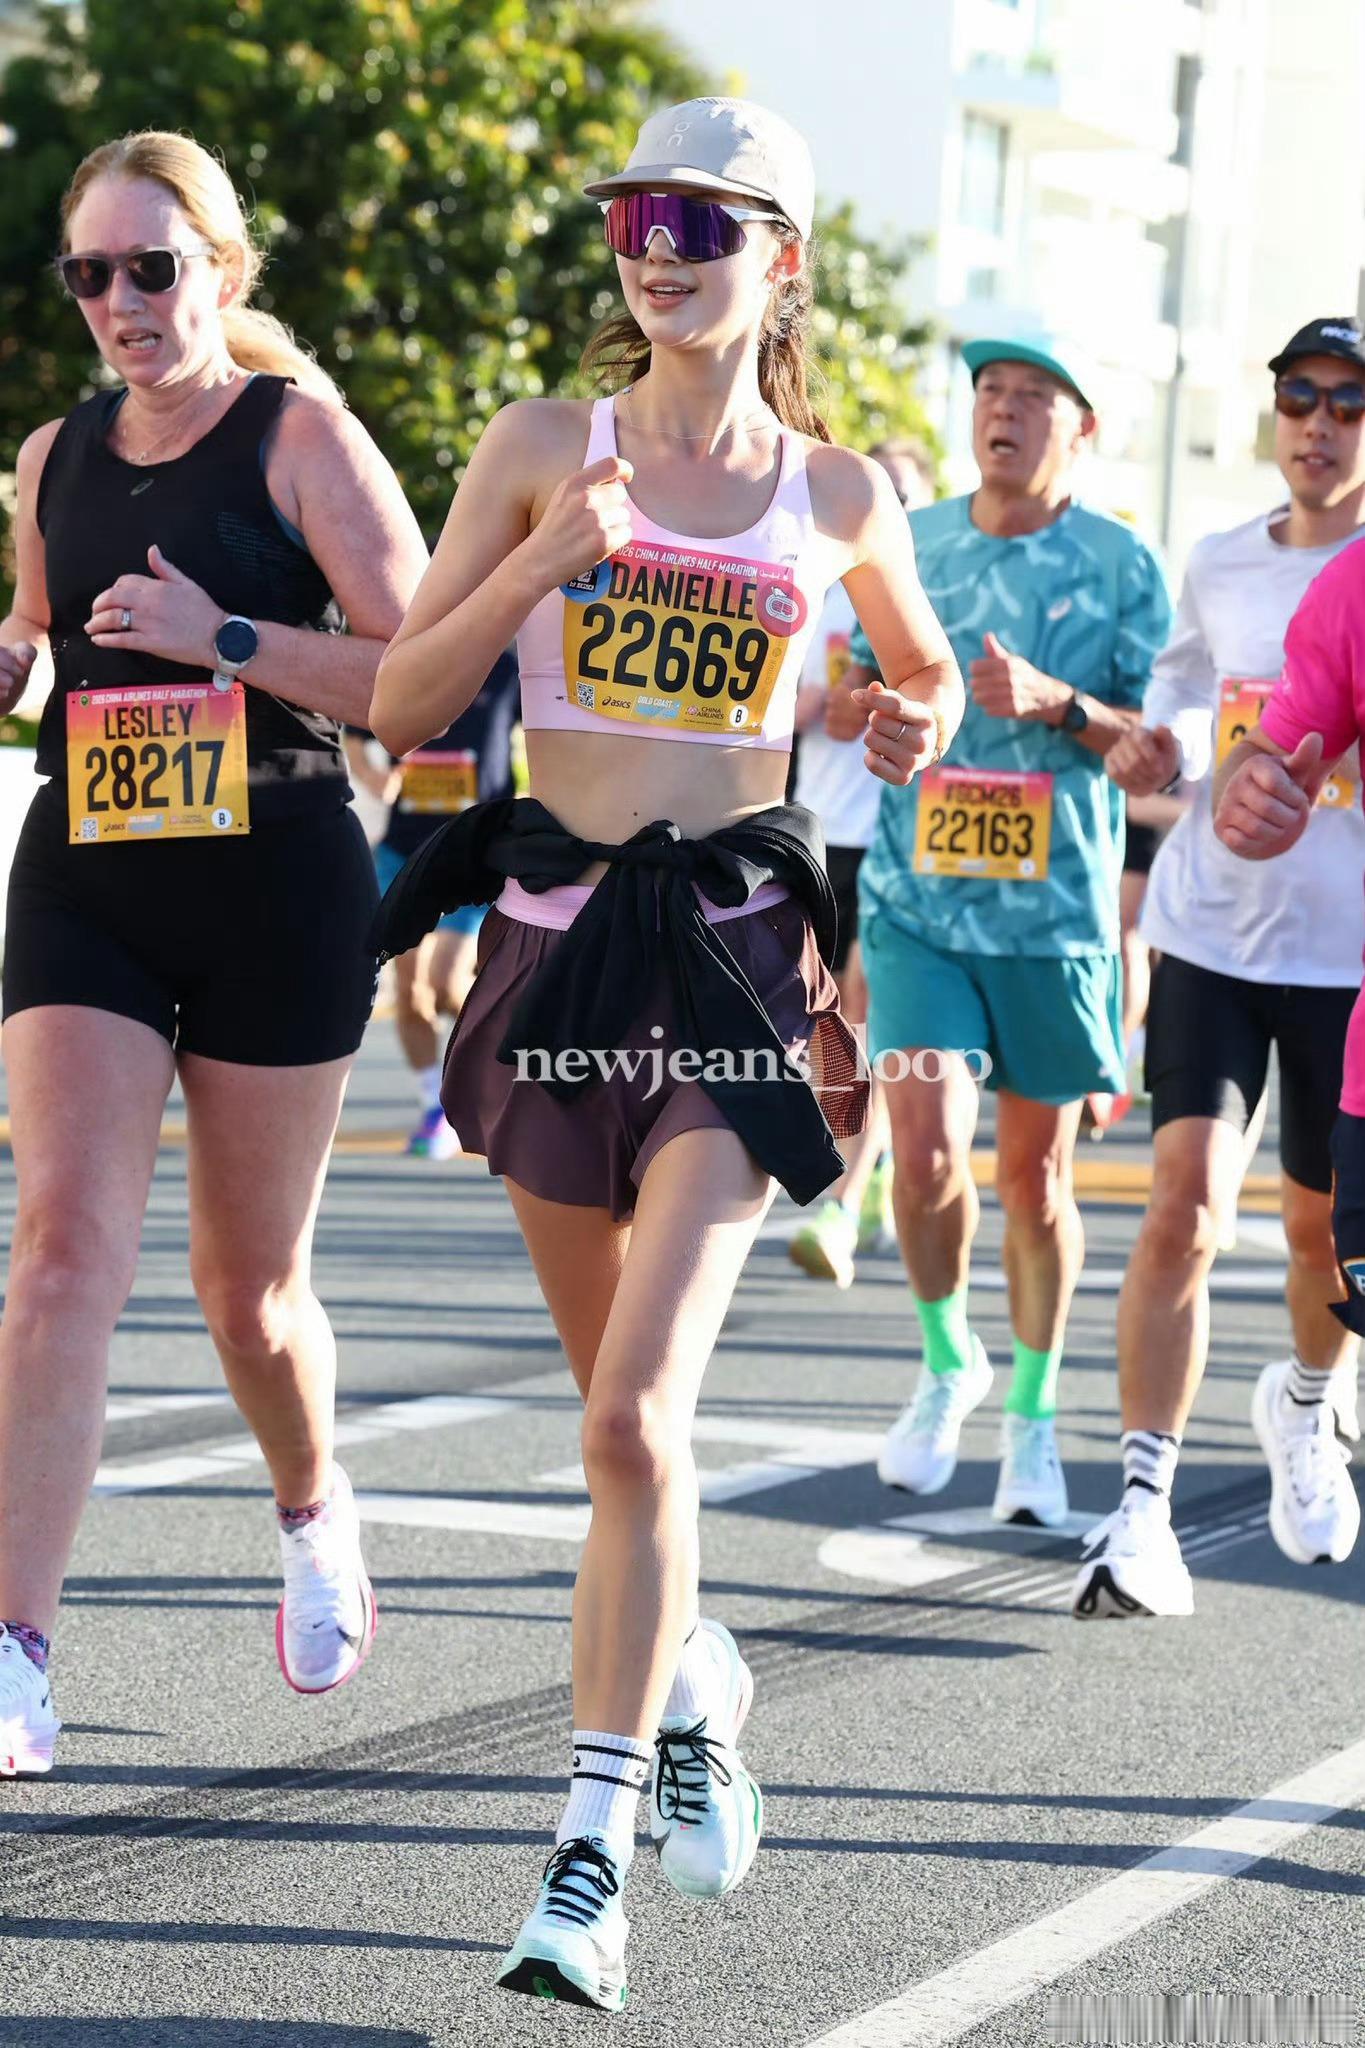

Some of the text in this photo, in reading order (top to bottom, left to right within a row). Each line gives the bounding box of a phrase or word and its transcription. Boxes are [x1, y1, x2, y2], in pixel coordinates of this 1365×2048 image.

[634, 547, 659, 562] CHINA
[660, 551, 697, 568] AIRLINES
[697, 558, 718, 572] HALF
[719, 562, 758, 578] MARATHON
[608, 561, 758, 621] DANIELLE
[578, 602, 770, 701] 22669
[104, 703, 194, 740] LESLEY
[735, 709, 743, 723] B
[85, 740, 225, 812] 28217
[217, 812, 226, 825] B
[928, 808, 1034, 857] 22163
